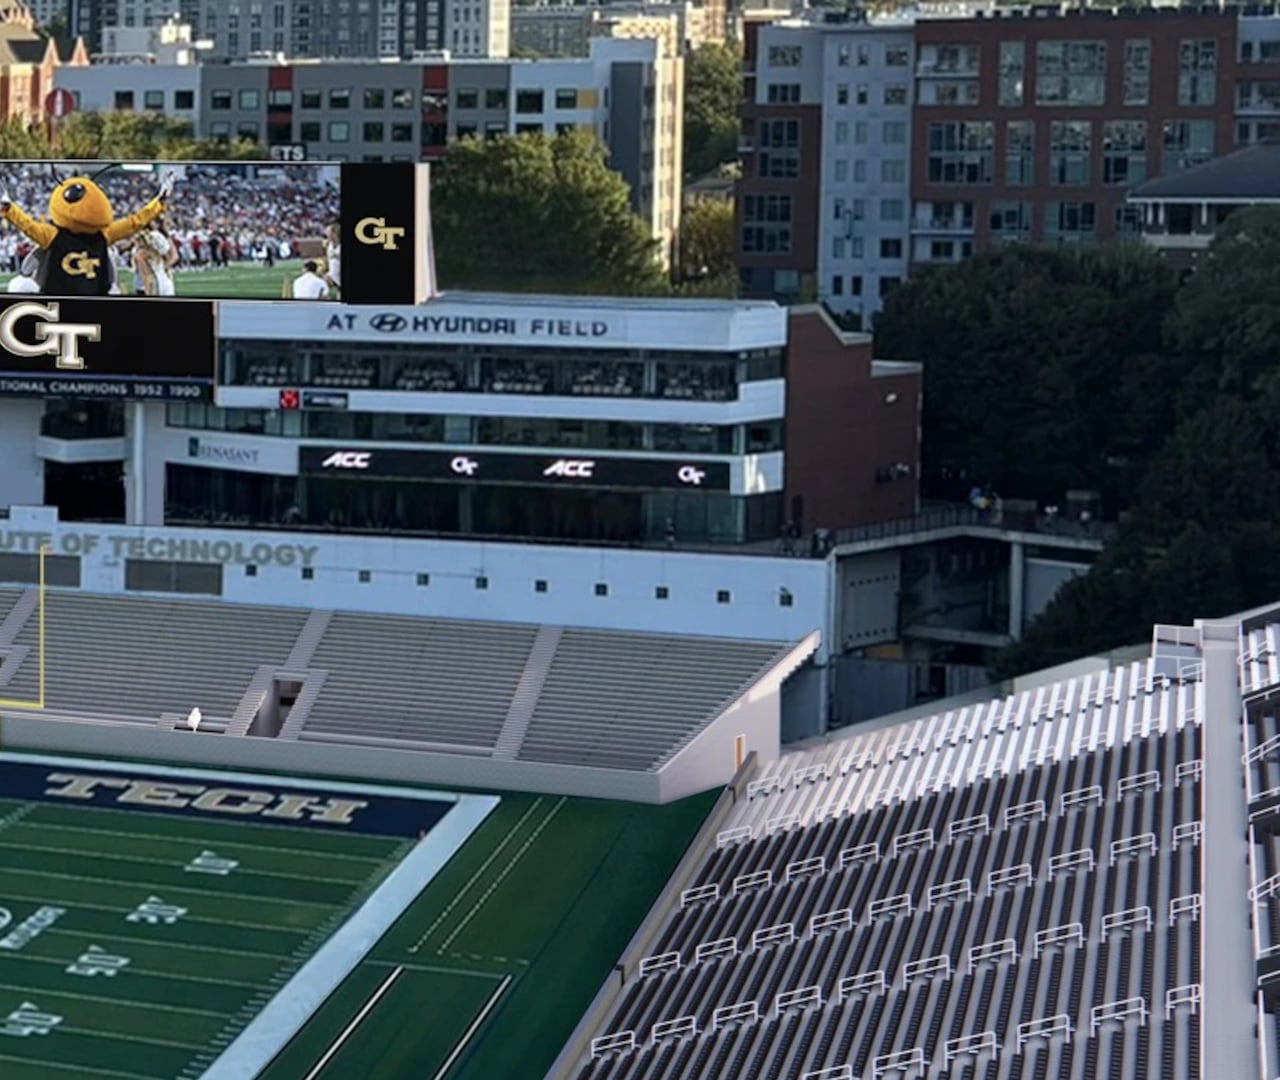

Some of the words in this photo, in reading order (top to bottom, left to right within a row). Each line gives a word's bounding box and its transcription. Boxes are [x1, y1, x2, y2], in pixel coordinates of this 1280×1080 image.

[354, 217, 405, 251] GT
[327, 314, 358, 331] AT
[413, 315, 517, 335] HYUNDAI
[531, 318, 609, 338] FIELD
[49, 381, 129, 396] CHAMPIONS
[133, 384, 163, 396] 1952
[169, 385, 201, 397] 1990
[322, 452, 372, 469] ACC
[543, 460, 595, 478] ACC
[62, 532, 99, 556] OF
[107, 535, 320, 567] TECHNOLOGY
[43, 771, 369, 826] TECH
